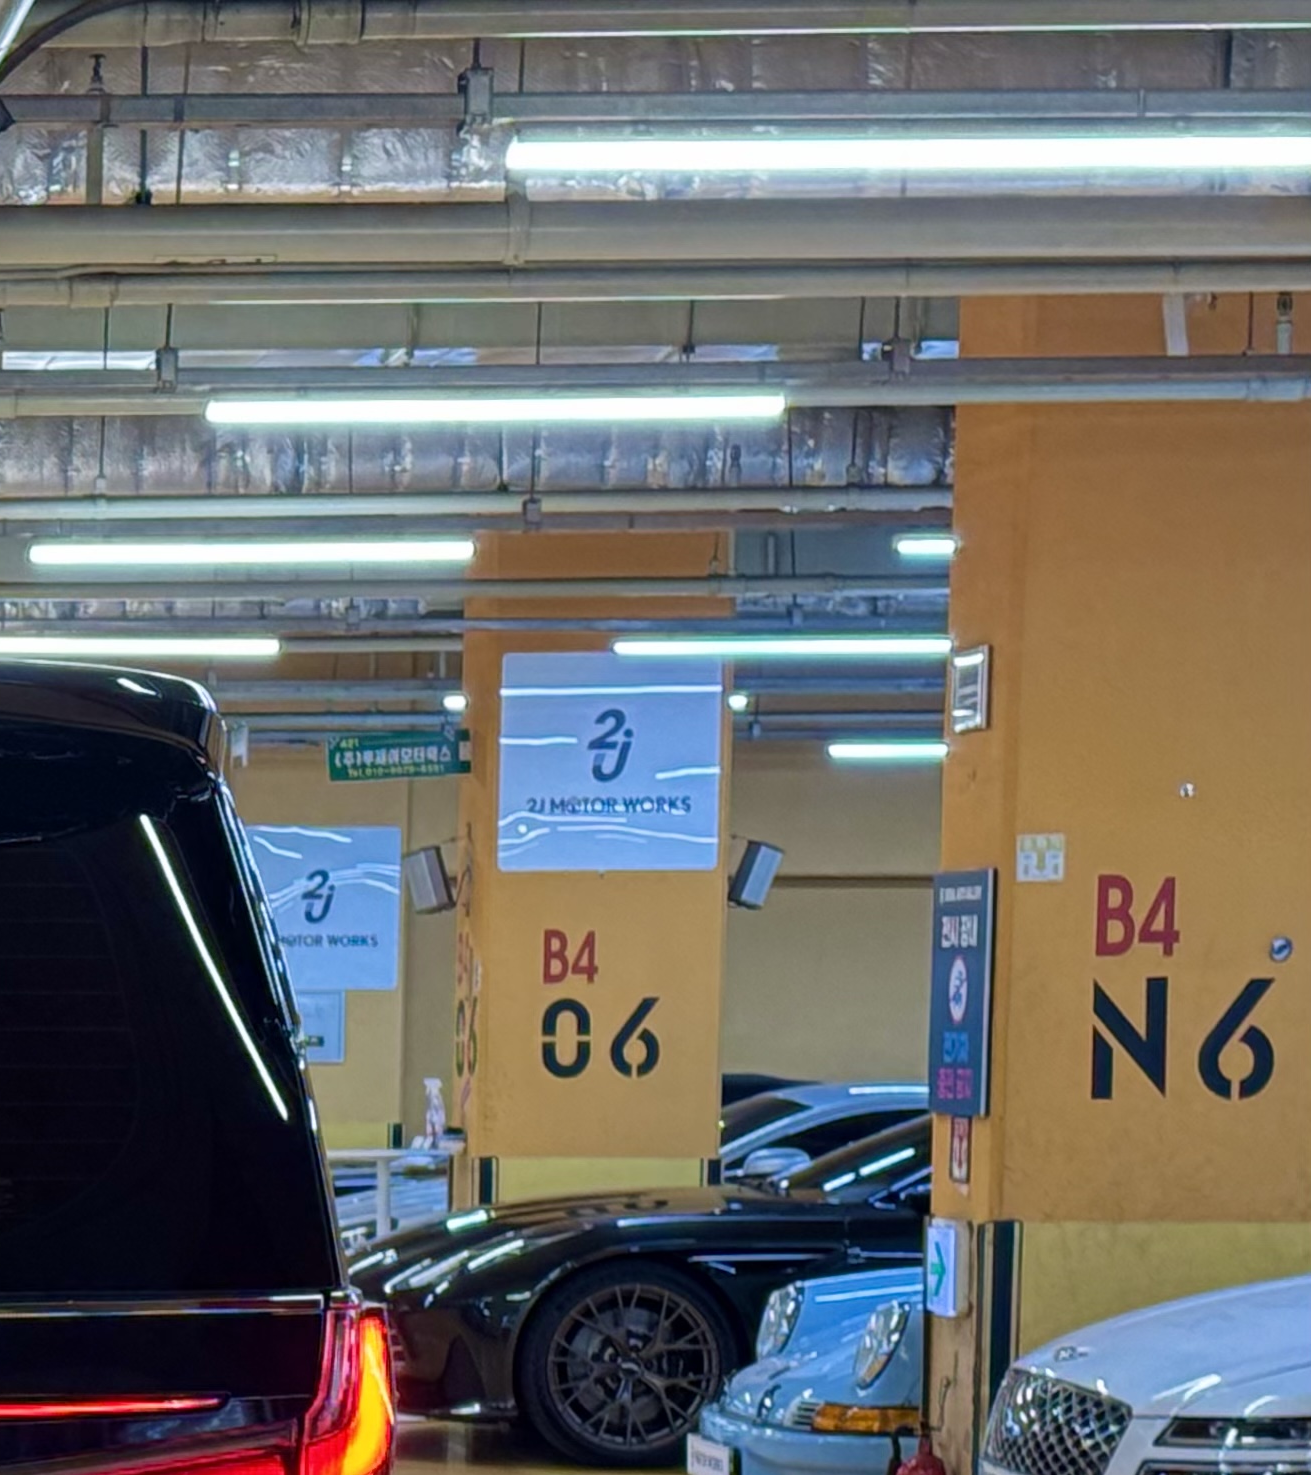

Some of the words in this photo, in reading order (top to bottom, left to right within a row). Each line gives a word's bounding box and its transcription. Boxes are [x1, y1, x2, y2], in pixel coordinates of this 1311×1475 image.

[551, 797, 625, 814] MOTOR
[627, 796, 692, 814] WORKS
[1095, 874, 1180, 957] B4
[327, 934, 379, 948] WORKS
[542, 929, 598, 984] B4
